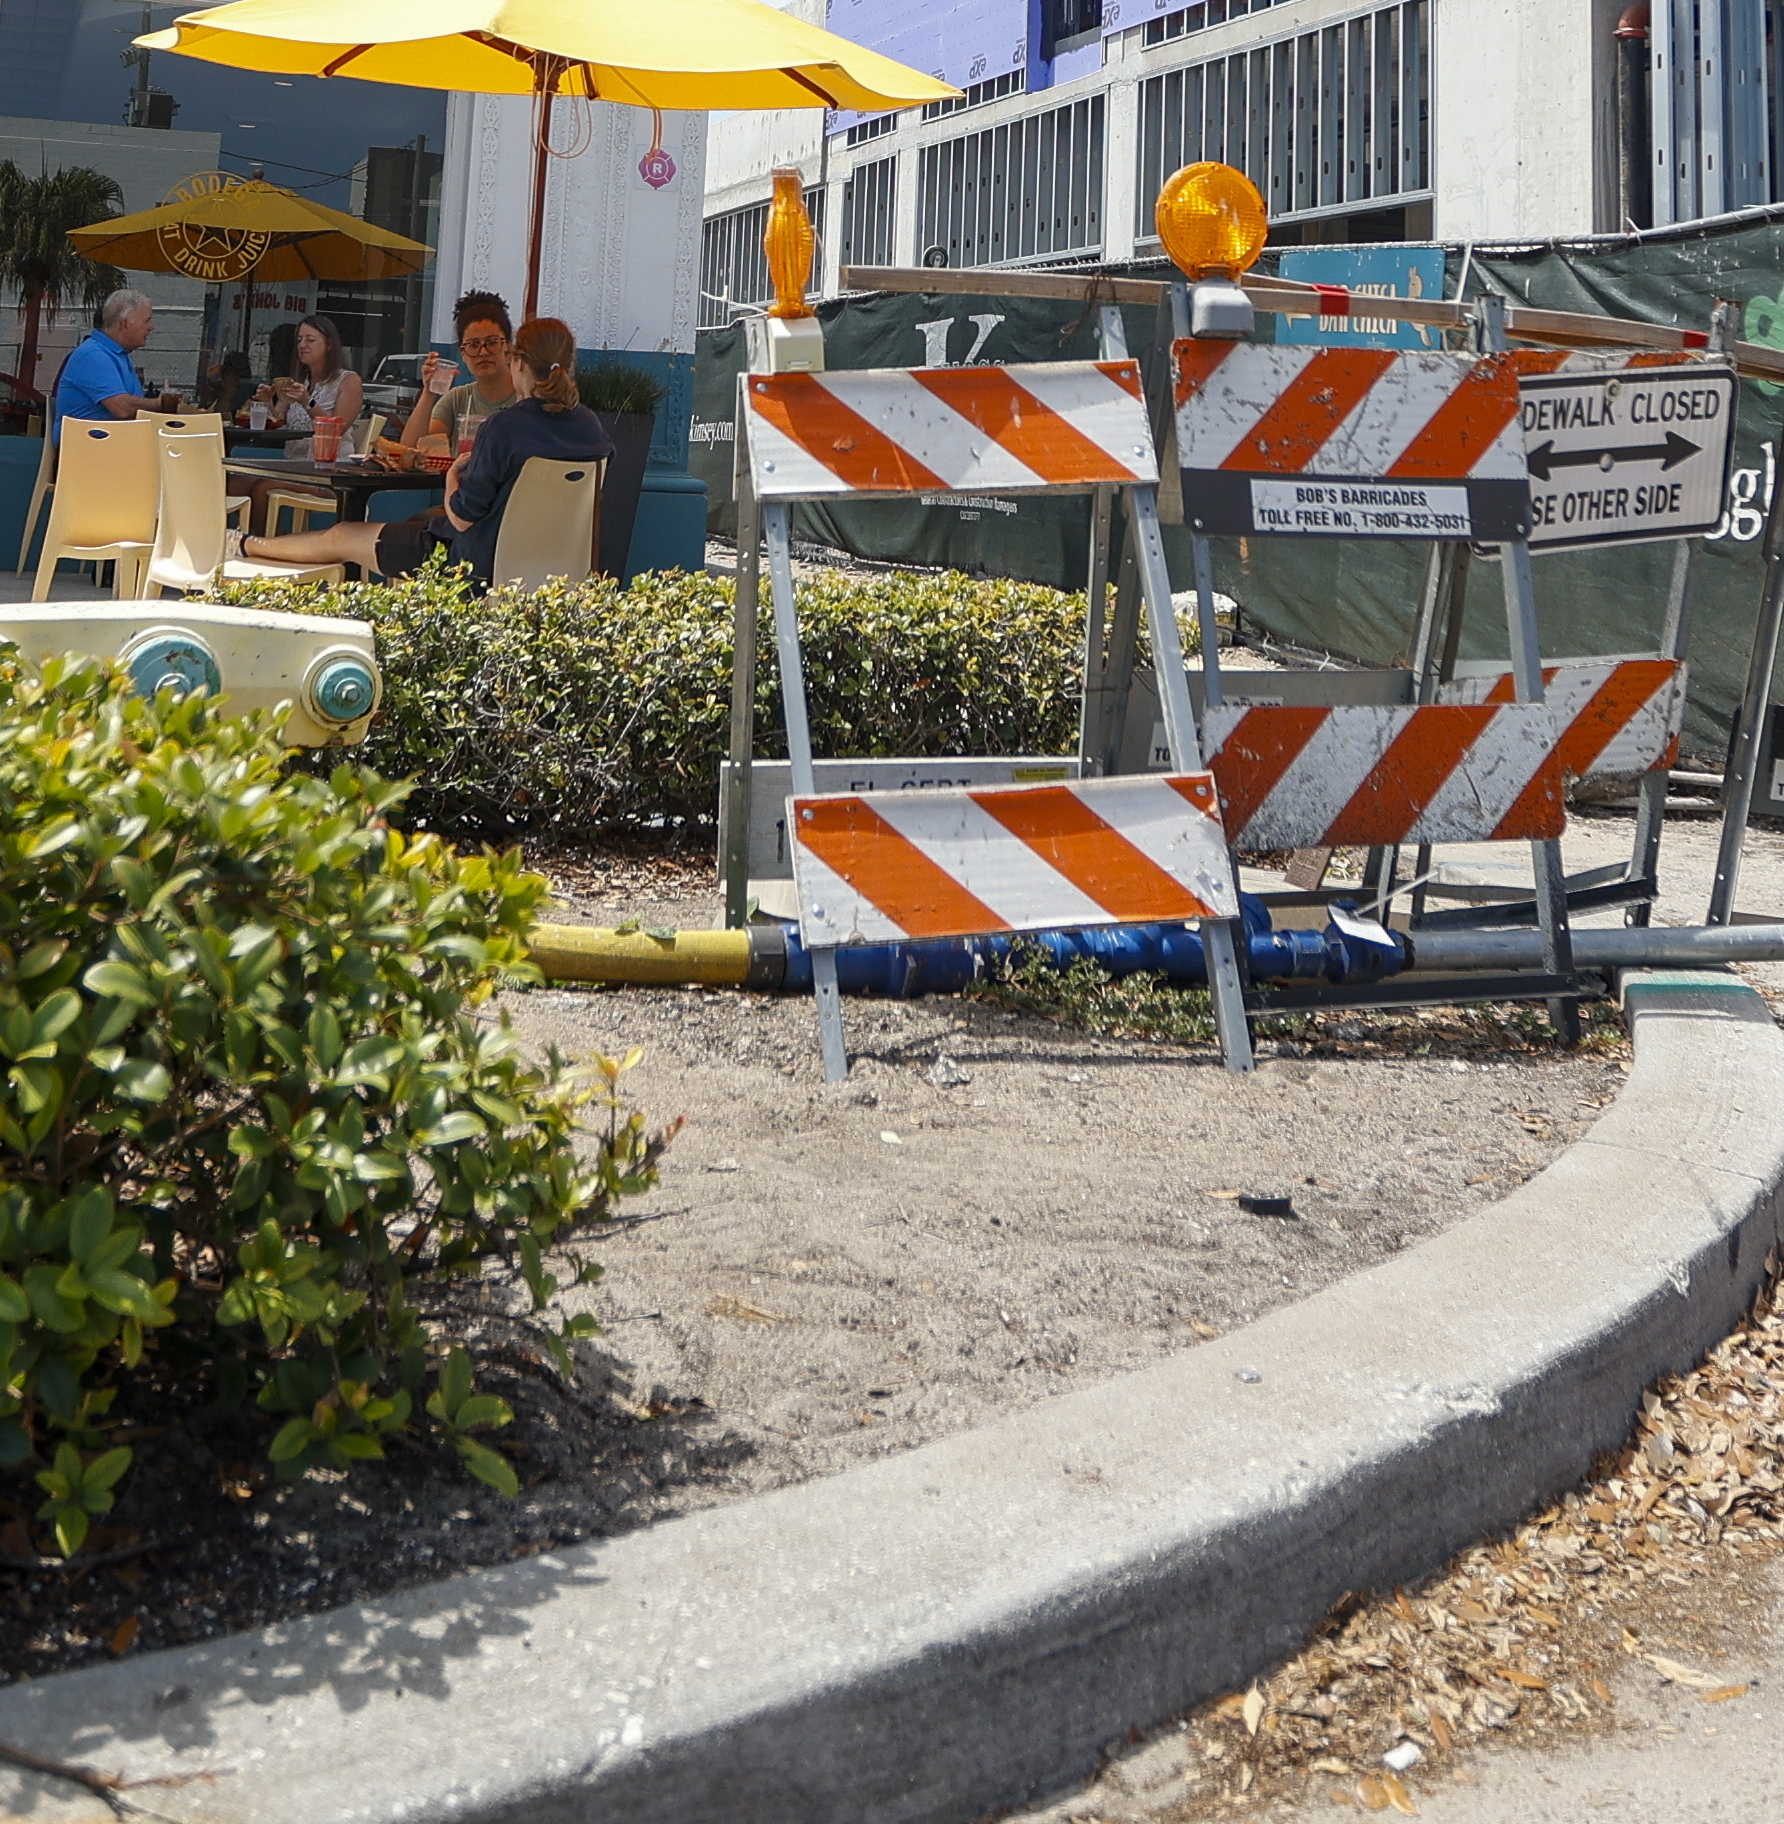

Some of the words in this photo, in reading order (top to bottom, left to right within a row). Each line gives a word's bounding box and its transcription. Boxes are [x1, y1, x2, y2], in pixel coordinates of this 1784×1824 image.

[653, 162, 663, 174] R
[174, 247, 228, 278] DRINK
[1523, 398, 1615, 432] DEWALK
[1631, 389, 1720, 423] CLOSED
[1296, 487, 1338, 504] BOB'S
[1342, 488, 1427, 507] BARRICADES
[1533, 495, 1557, 525] SE
[1562, 487, 1629, 522] OTHER
[1634, 483, 1683, 516] SIDE
[1259, 509, 1291, 525] TOLL
[1296, 510, 1330, 526] FREE
[1362, 514, 1466, 530] 1-800-432-5031
